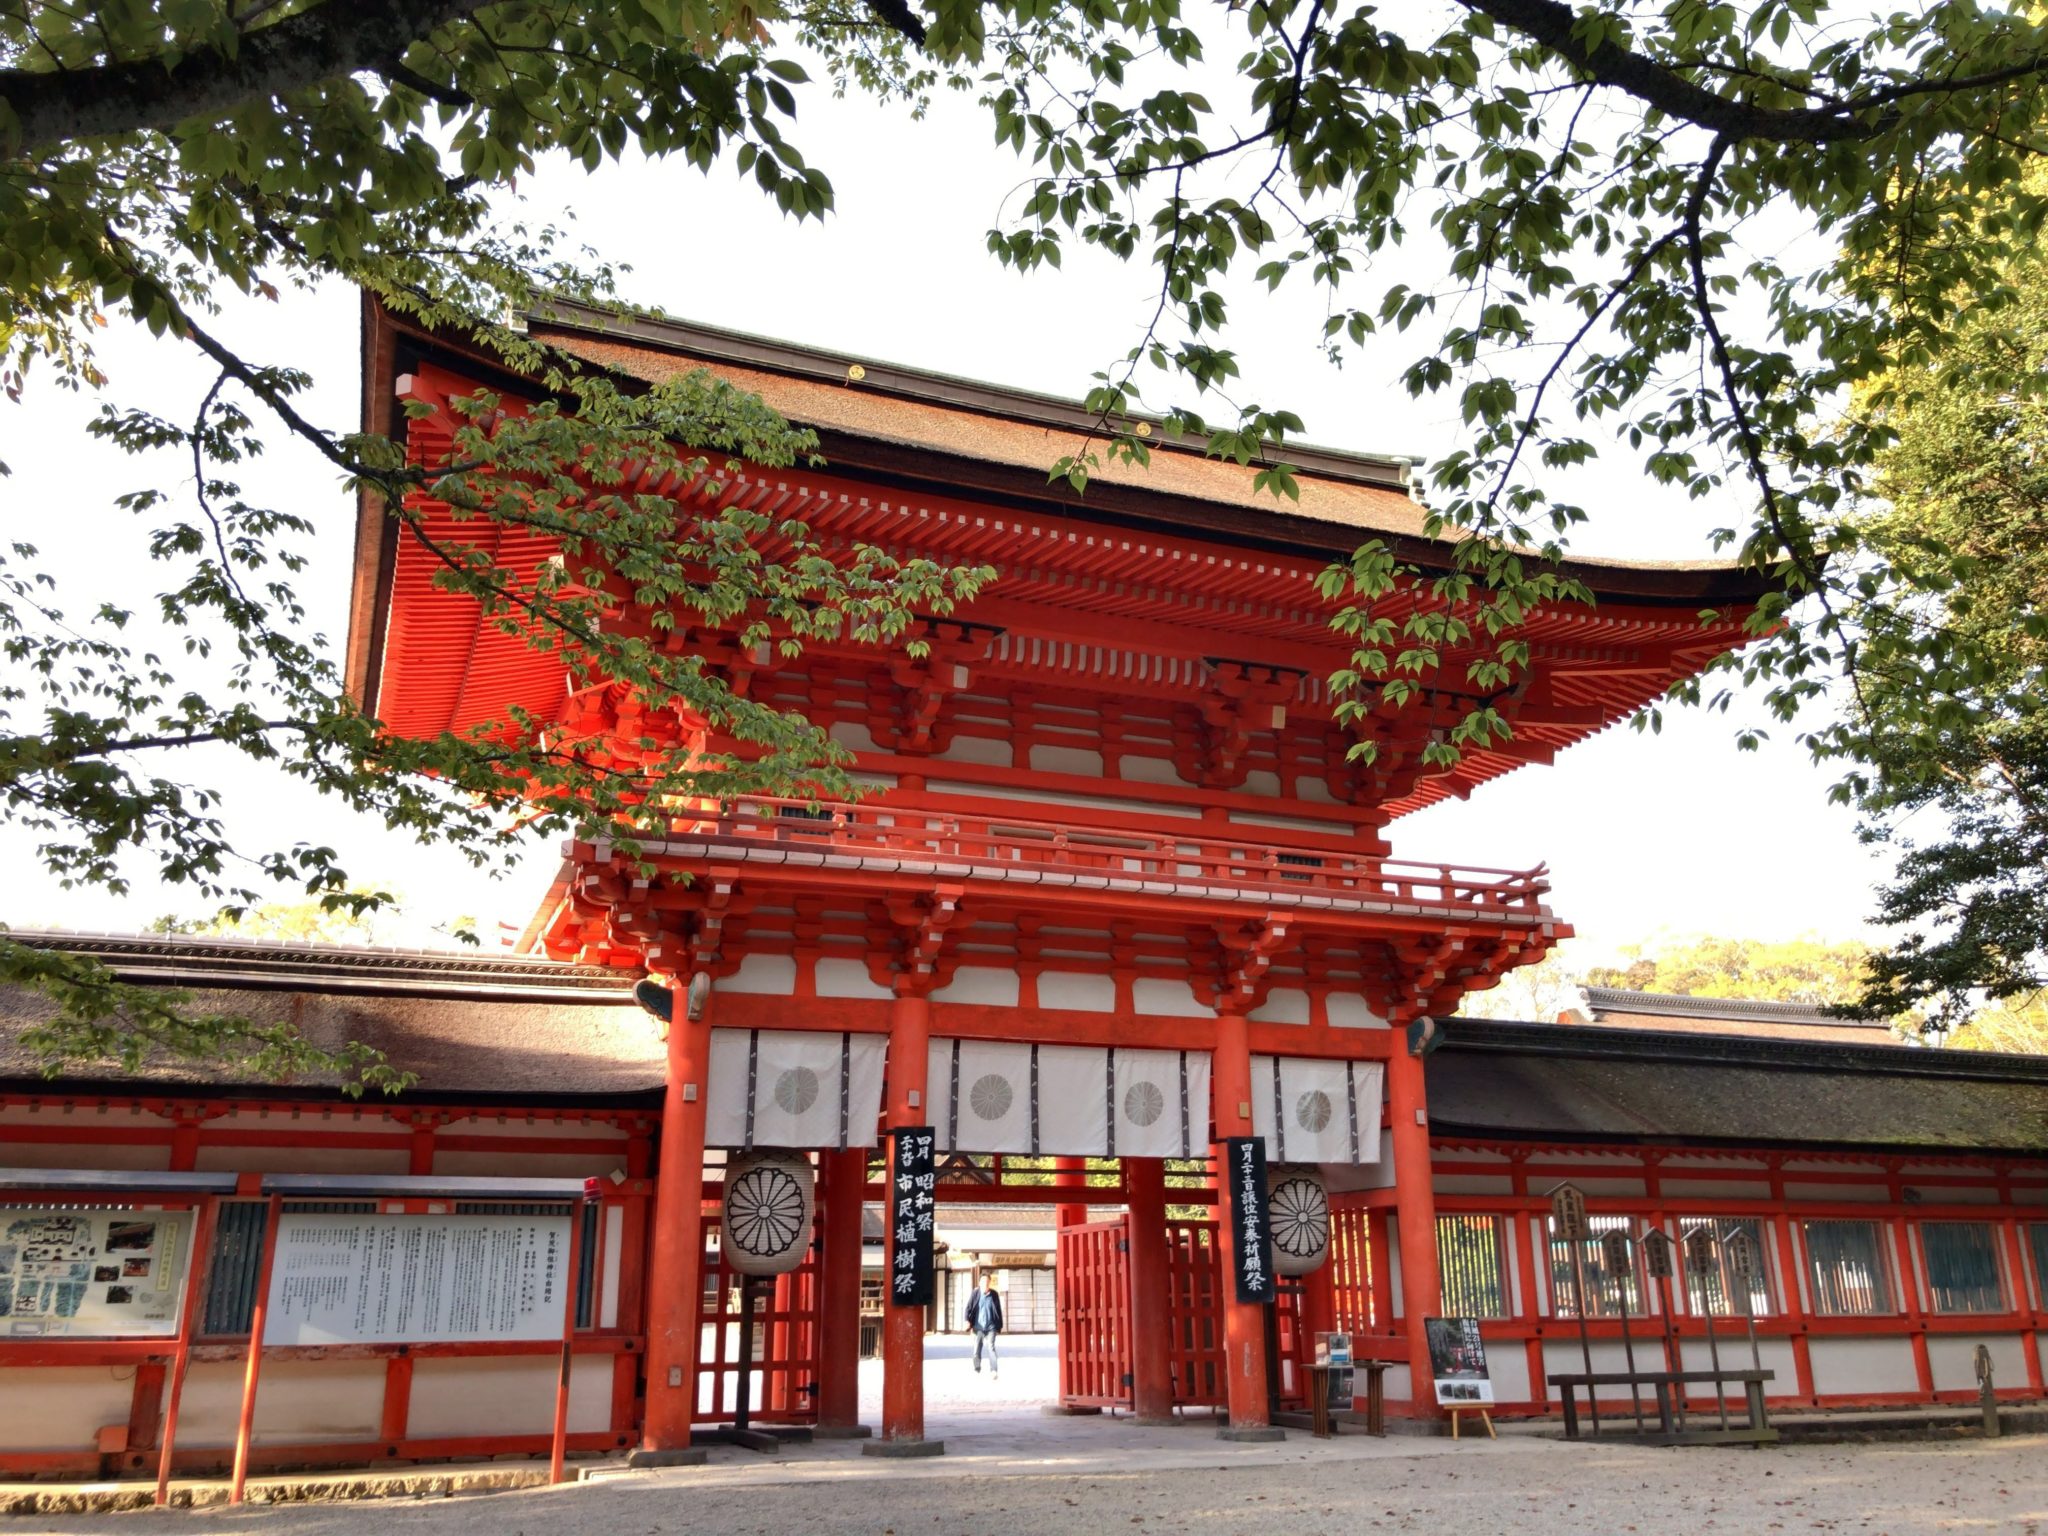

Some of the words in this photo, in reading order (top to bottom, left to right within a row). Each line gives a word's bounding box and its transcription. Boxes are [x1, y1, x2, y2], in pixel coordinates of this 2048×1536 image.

[900, 1135, 915, 1167] 二十九日
[916, 1136, 932, 1160] 四月
[915, 1172, 934, 1232] 昭和祭
[894, 1173, 917, 1294] 市民植樹祭
